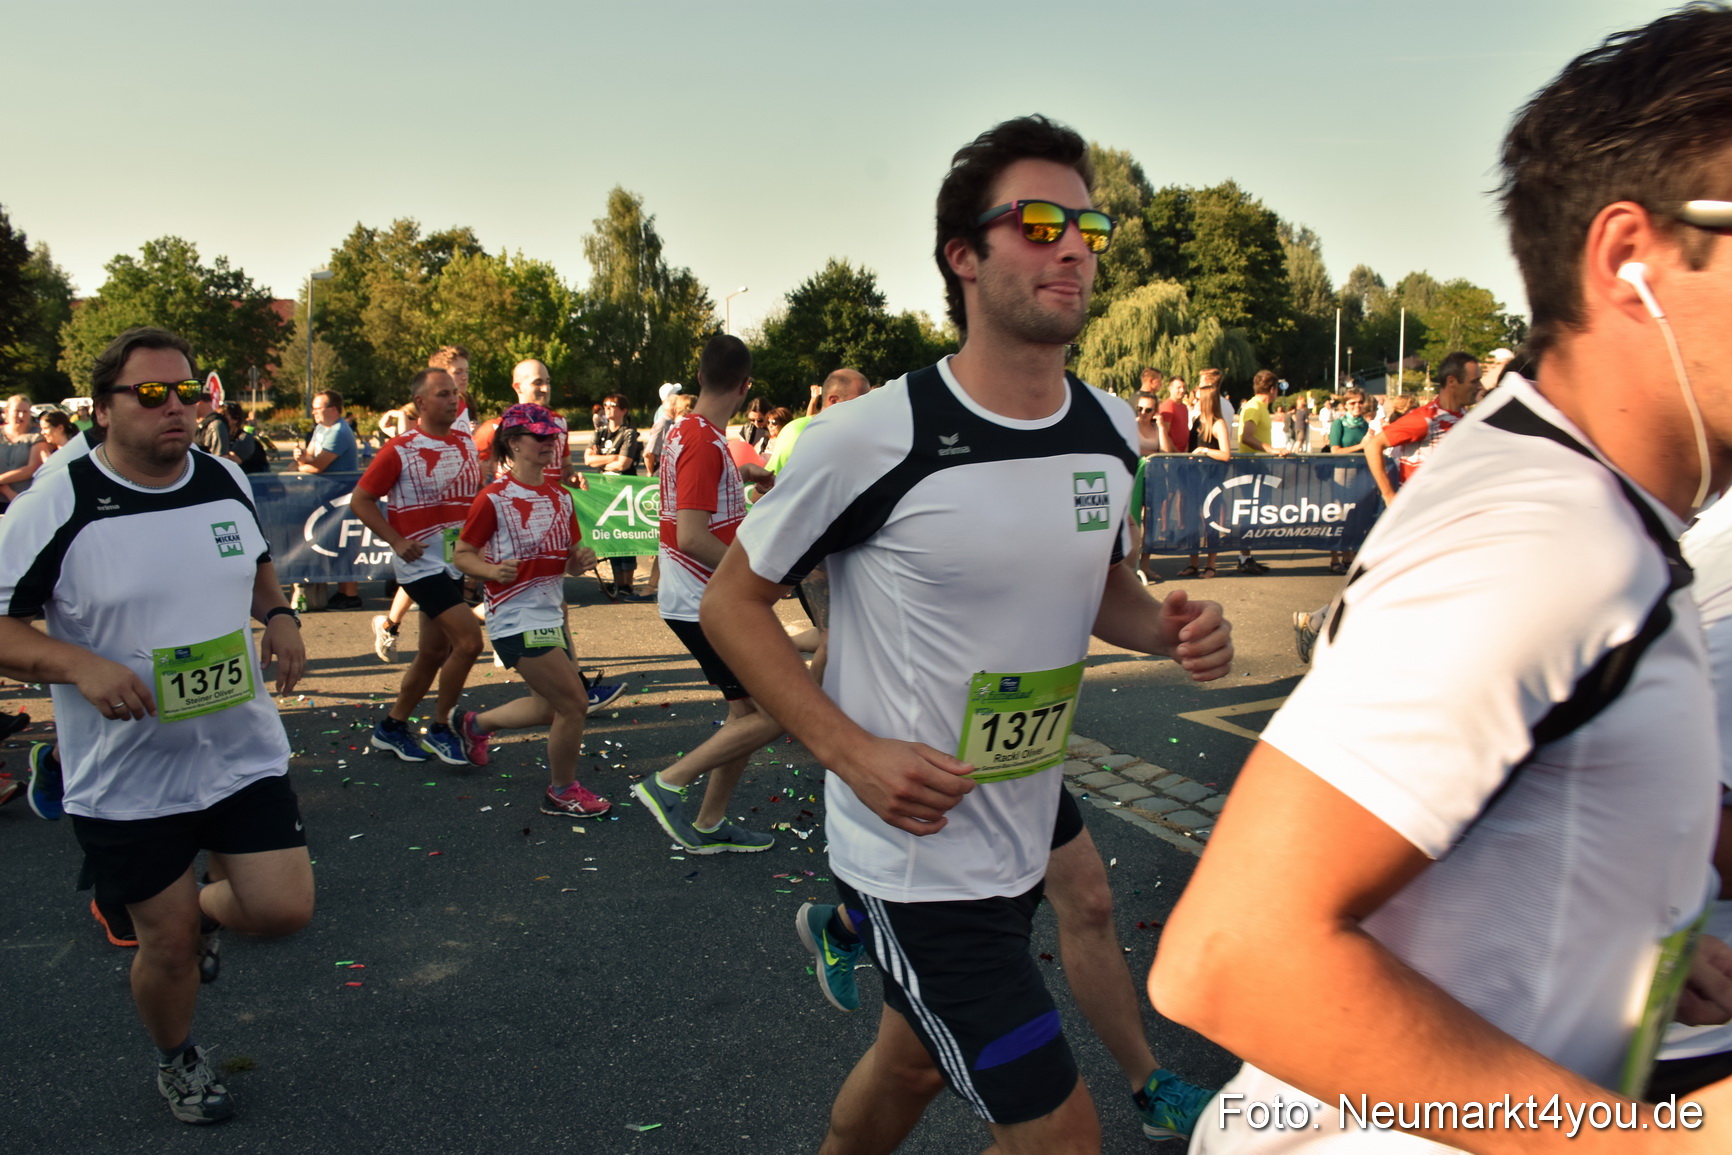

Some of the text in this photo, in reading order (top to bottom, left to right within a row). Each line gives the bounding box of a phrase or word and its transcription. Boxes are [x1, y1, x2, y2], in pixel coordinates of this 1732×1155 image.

[1074, 494, 1110, 508] MICKAN
[1232, 497, 1356, 525] Fischer
[215, 534, 241, 544] MICKAN
[592, 529, 610, 540] Die
[1242, 526, 1345, 540] AUTOMOBILE
[171, 658, 242, 698] 1375
[185, 694, 213, 705] Steiner
[214, 688, 235, 699] Oliver
[981, 702, 1068, 752] 1377
